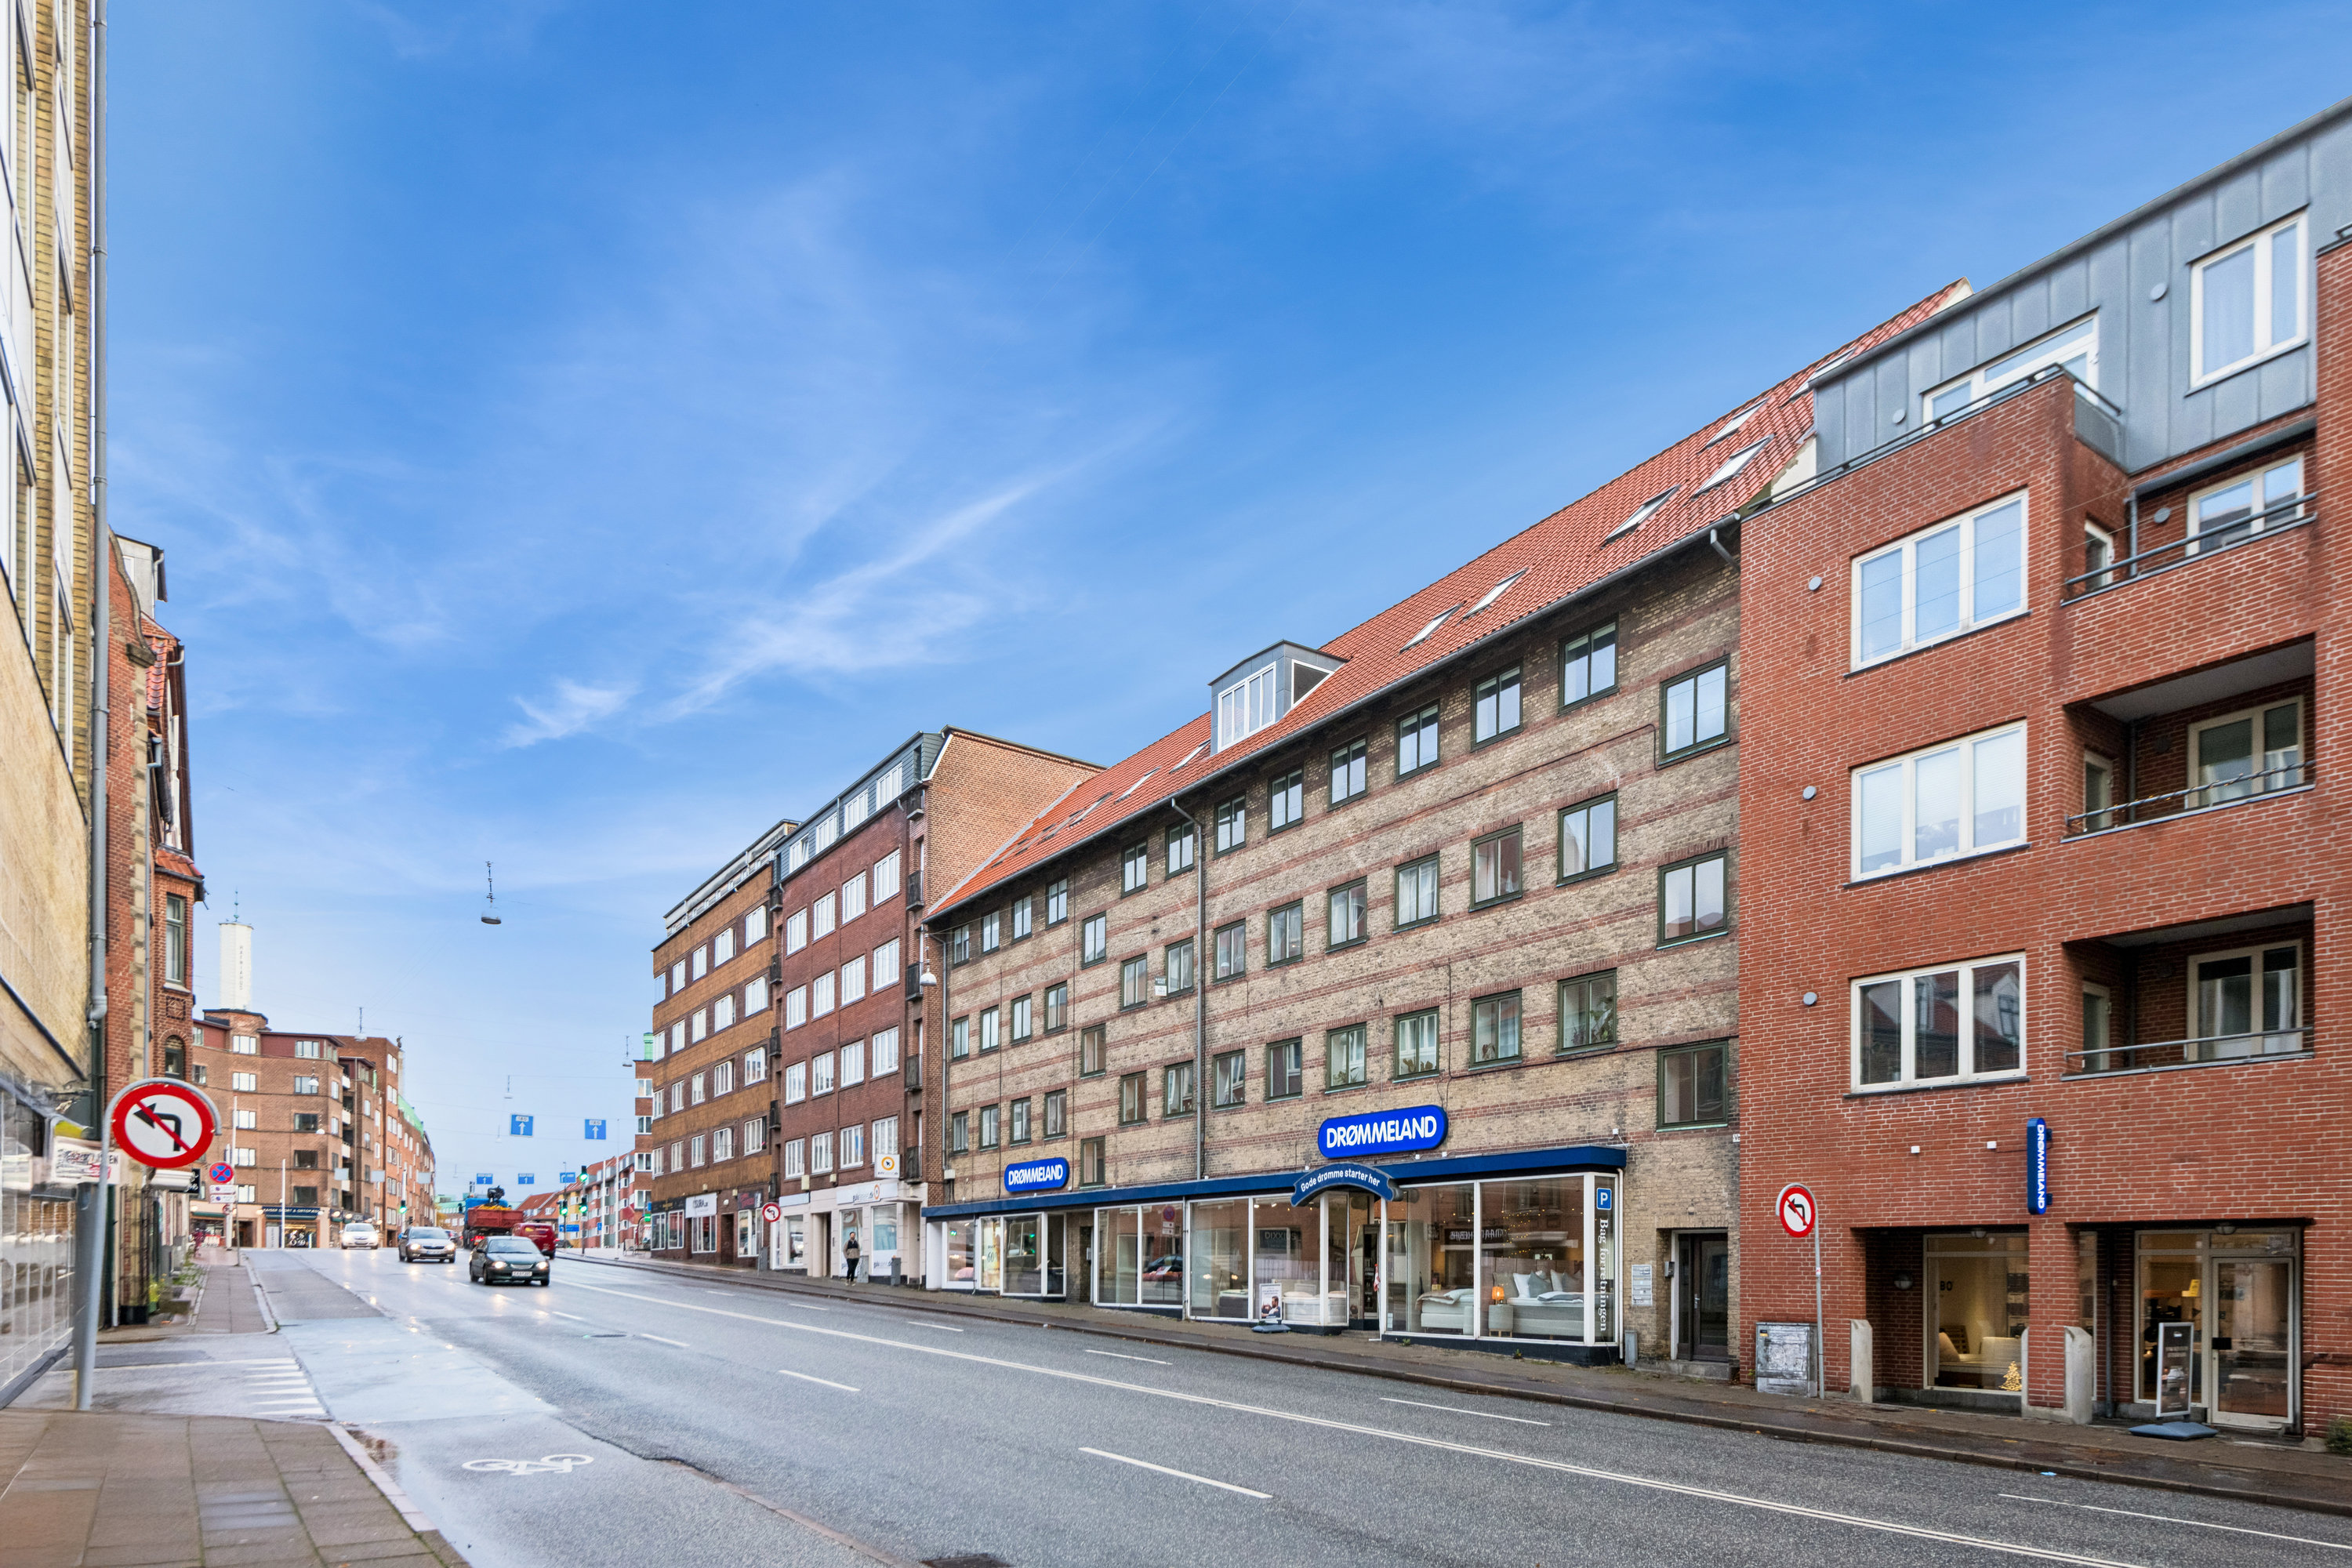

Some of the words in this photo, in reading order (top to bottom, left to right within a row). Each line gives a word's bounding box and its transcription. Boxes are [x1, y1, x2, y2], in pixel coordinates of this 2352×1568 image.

[1327, 1116, 1437, 1149] DRØMMELAND
[1008, 1164, 1063, 1185] DRØMMELAND
[2037, 1124, 2045, 1209] DRØMMELAND
[1301, 1177, 1317, 1192] Gode
[1317, 1169, 1344, 1183] drømme
[1345, 1168, 1368, 1181] starter
[1368, 1173, 1380, 1187] her
[1600, 1192, 1609, 1205] P
[1598, 1218, 1608, 1243] Bag
[1598, 1249, 1609, 1331] forretningen
